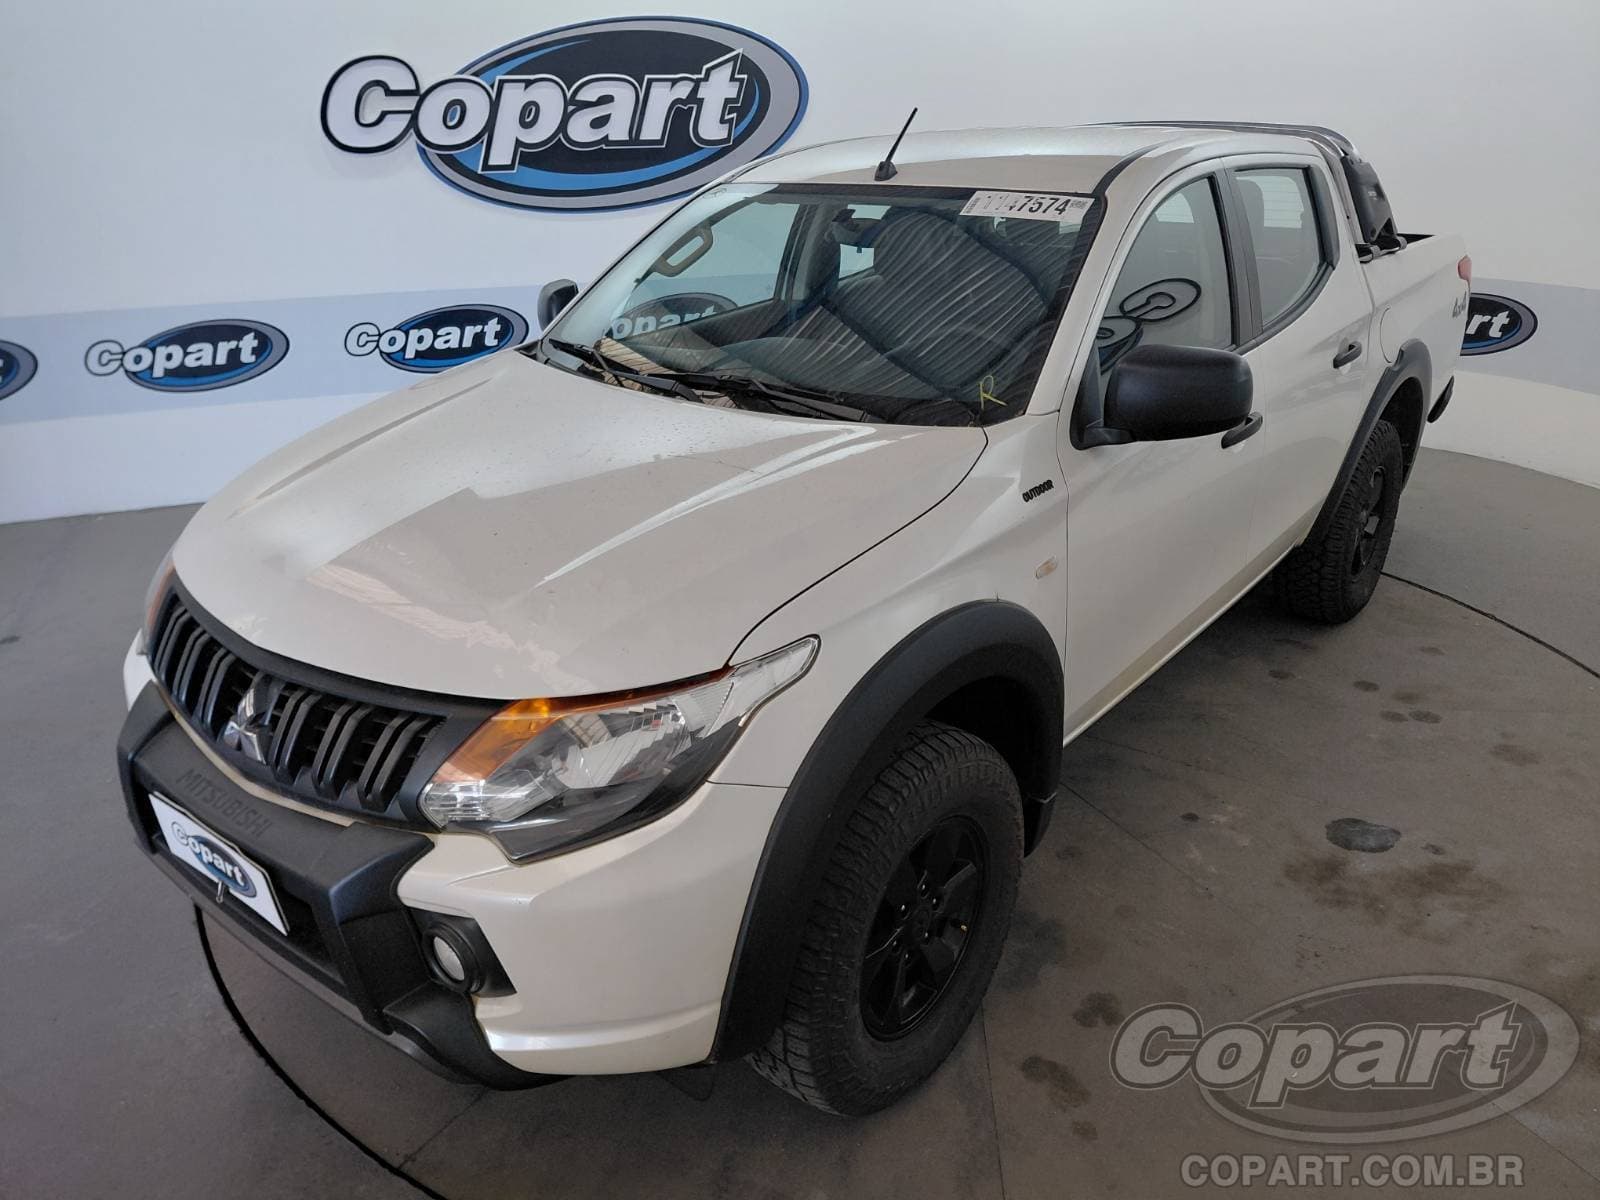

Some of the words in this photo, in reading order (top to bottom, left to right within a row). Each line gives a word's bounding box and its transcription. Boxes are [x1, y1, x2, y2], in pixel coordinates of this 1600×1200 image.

[321, 49, 747, 173] Copart
[85, 331, 258, 378] Copart
[344, 317, 501, 359] Copart
[1022, 479, 1054, 503] OUTDOOR
[176, 768, 273, 837] MITSUBISHI
[171, 821, 246, 886] Copart
